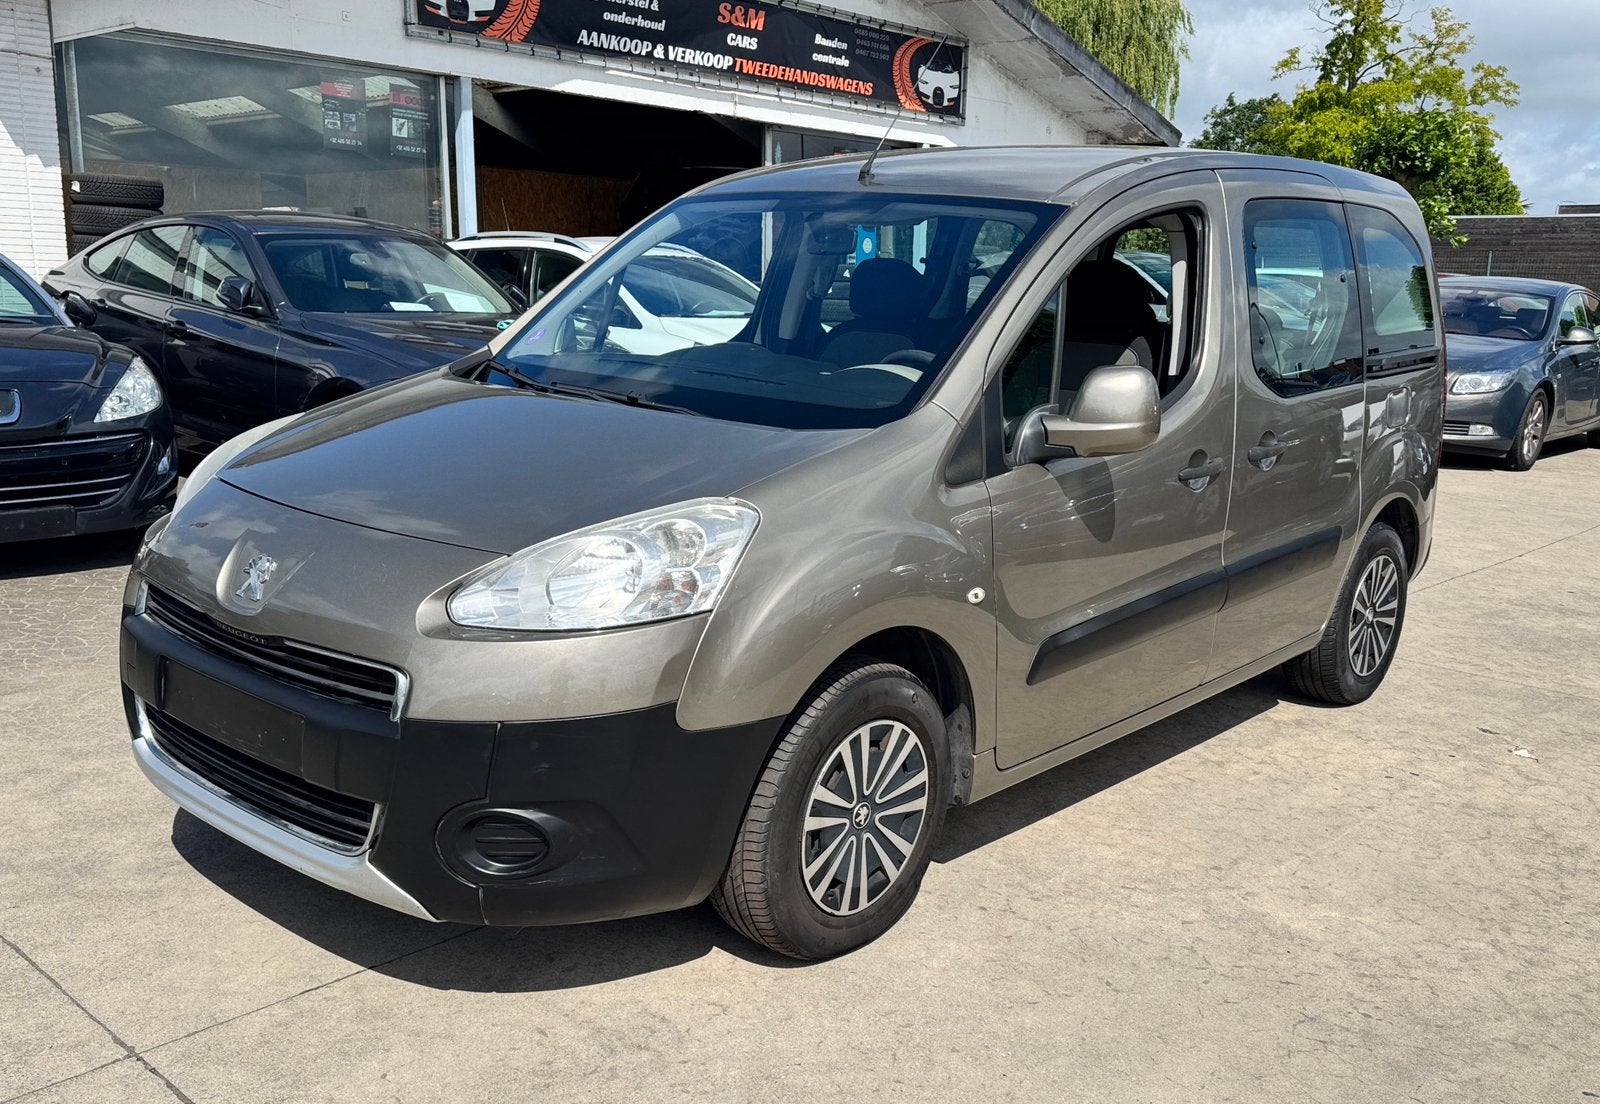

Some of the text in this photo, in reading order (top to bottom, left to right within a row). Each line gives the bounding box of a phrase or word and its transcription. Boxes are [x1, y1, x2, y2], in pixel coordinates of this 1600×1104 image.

[607, 0, 659, 11] rstel &
[603, 11, 666, 31] onderhoud
[717, 2, 766, 31] S&M
[726, 32, 758, 50] CARS
[814, 33, 848, 50] Banden
[577, 29, 874, 95] AANKOOP & VERKOOP TWEEDEHANDSWAGENS
[812, 52, 850, 67] centrale
[216, 621, 267, 645] PEUGEOT
